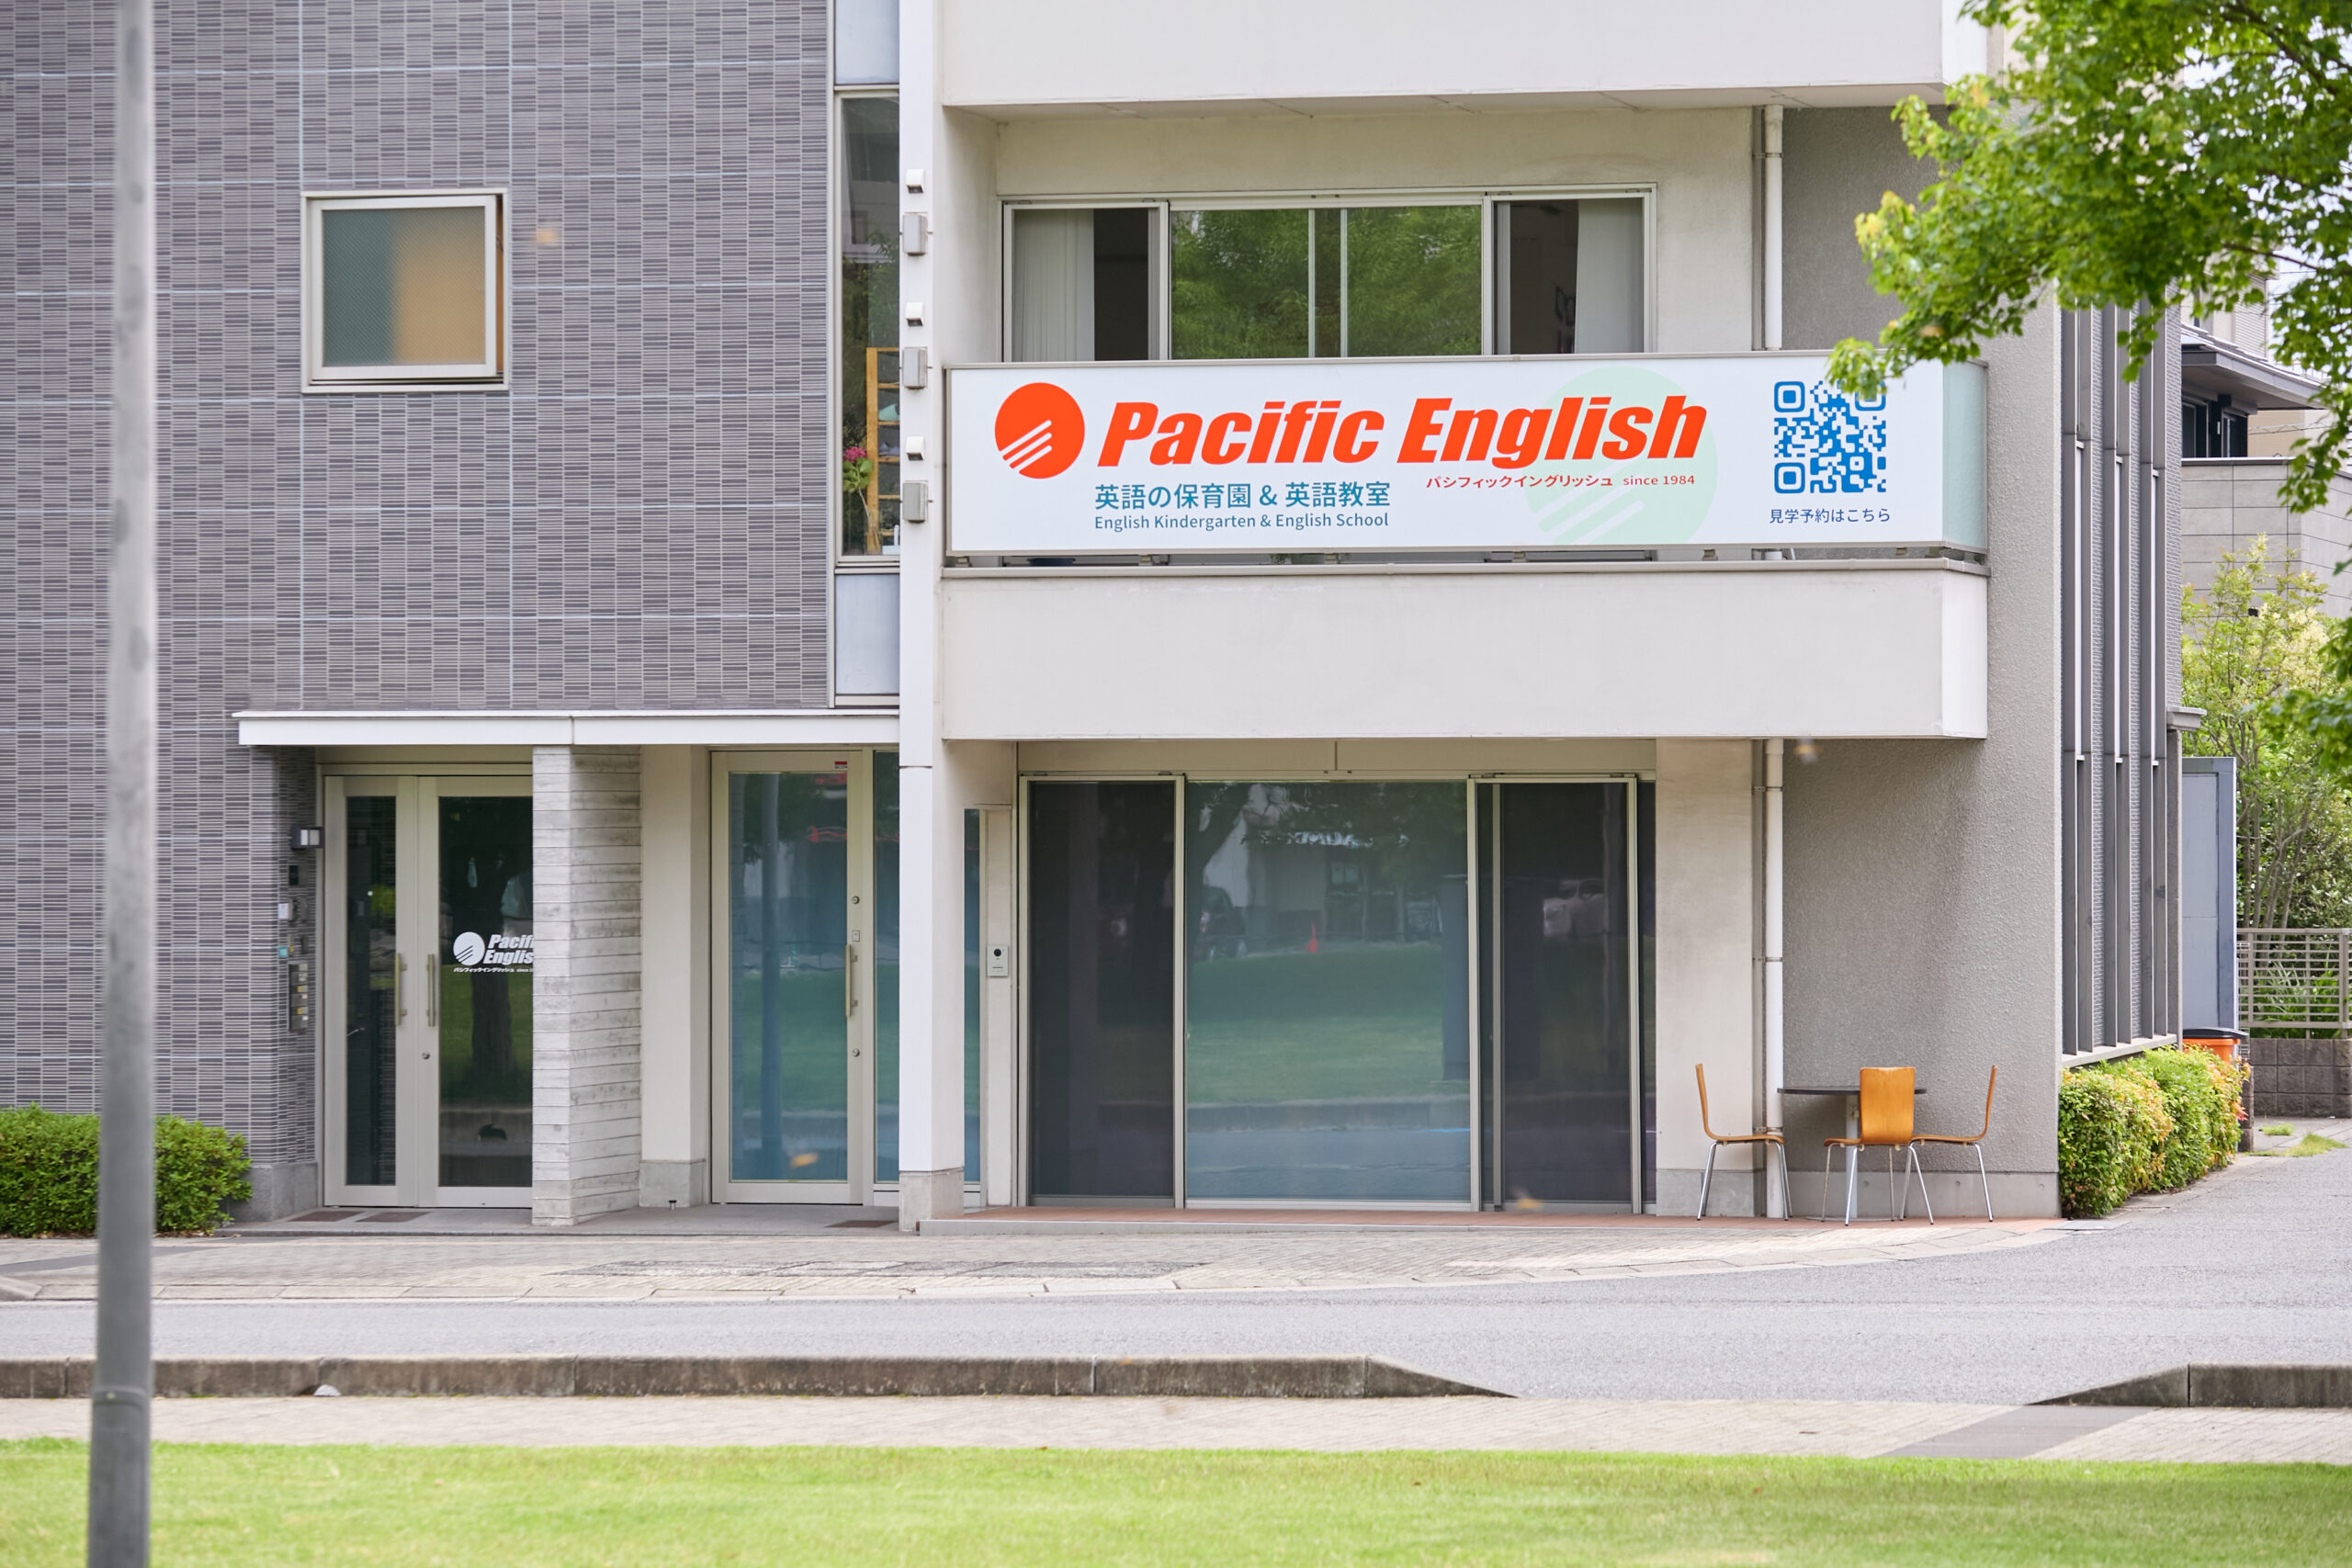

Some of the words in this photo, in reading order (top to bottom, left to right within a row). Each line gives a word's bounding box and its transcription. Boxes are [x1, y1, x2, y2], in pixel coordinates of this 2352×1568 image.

[1097, 400, 1385, 467] Pacific
[1396, 395, 1707, 469] English
[1426, 474, 1613, 489] パシフィックイングリッシュ
[1623, 476, 1658, 486] since
[1663, 475, 1695, 485] 1984
[1095, 482, 1250, 510] 英語の保育園
[1259, 484, 1278, 506] &
[1285, 480, 1390, 507] 英語教室
[1095, 515, 1149, 533] English
[1154, 514, 1256, 532] Kindergarten
[1261, 514, 1272, 527] &
[1276, 513, 1331, 530] English
[1337, 513, 1389, 526] School
[1770, 508, 1890, 524] 見学予約はこちら
[488, 934, 533, 949] Pacif
[482, 950, 533, 964] Englis
